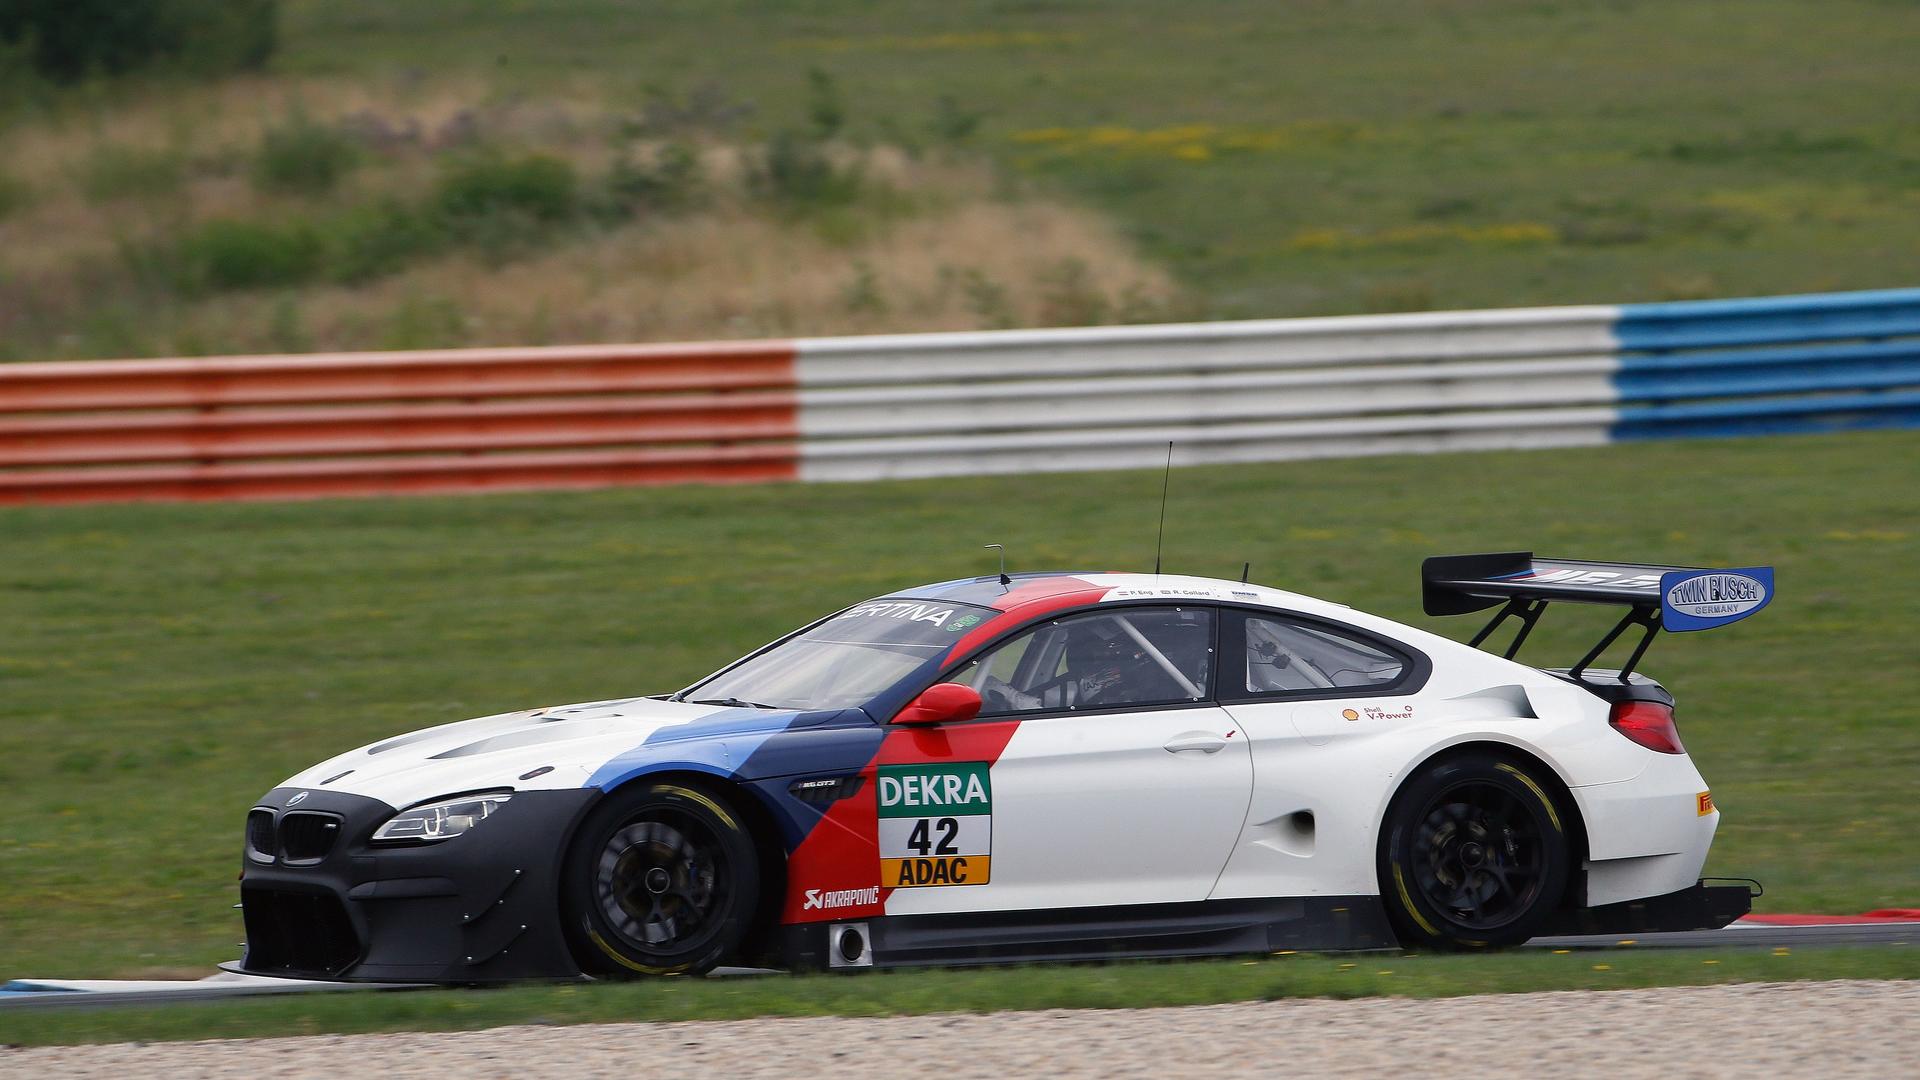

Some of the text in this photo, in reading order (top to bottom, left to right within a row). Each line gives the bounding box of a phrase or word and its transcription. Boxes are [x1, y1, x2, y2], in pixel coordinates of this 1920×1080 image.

[1672, 575, 1758, 603] TWIN BUSCH
[1695, 604, 1739, 615] GERMANY
[1366, 712, 1413, 720] V-Power
[879, 773, 988, 807] DEKRA
[907, 817, 959, 856] 42
[898, 857, 968, 886] ADAC
